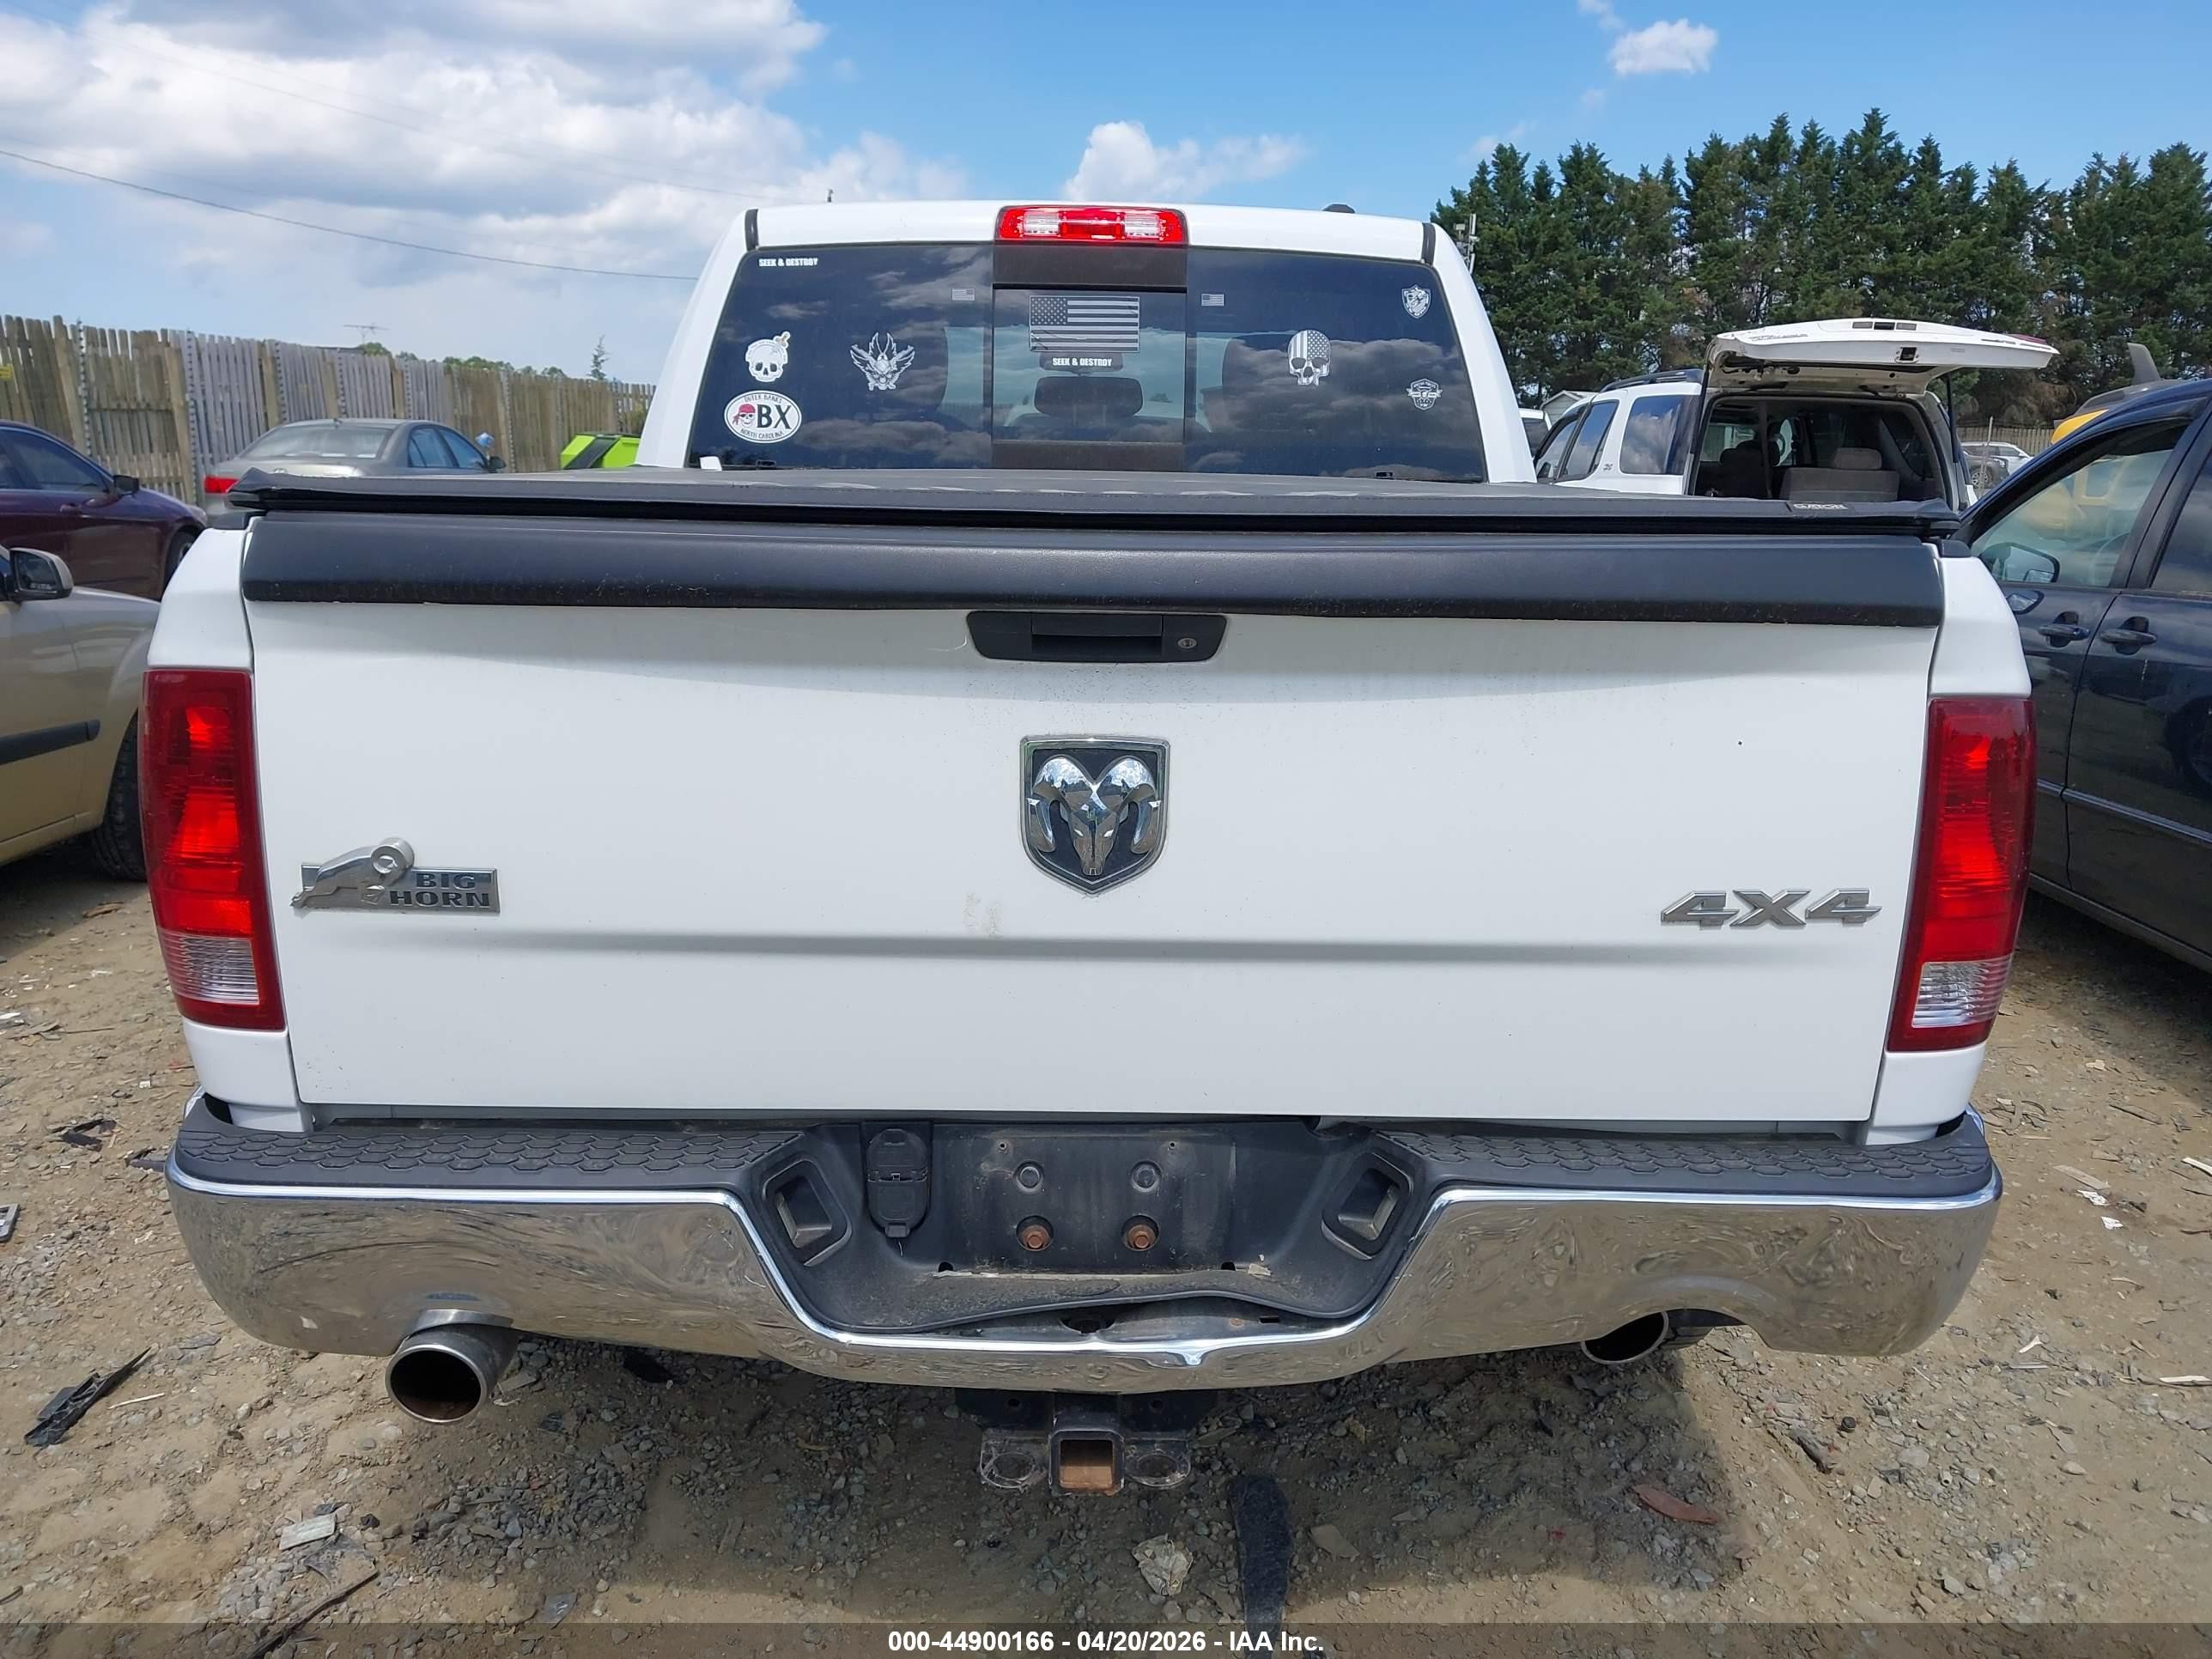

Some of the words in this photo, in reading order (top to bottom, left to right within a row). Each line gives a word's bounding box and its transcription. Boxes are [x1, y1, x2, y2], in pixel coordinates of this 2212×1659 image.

[758, 258, 776, 267] SEEK
[777, 258, 785, 267] &
[786, 257, 818, 266] DESTROY
[1052, 357, 1070, 366] SEEK
[1079, 358, 1112, 367] DESTROY
[763, 394, 782, 404] BANKS
[739, 428, 757, 438] NORTH
[758, 430, 785, 440] CAROLINA
[416, 872, 476, 890] BIG
[389, 890, 490, 908] HORN
[1660, 888, 1883, 927] 4X4
